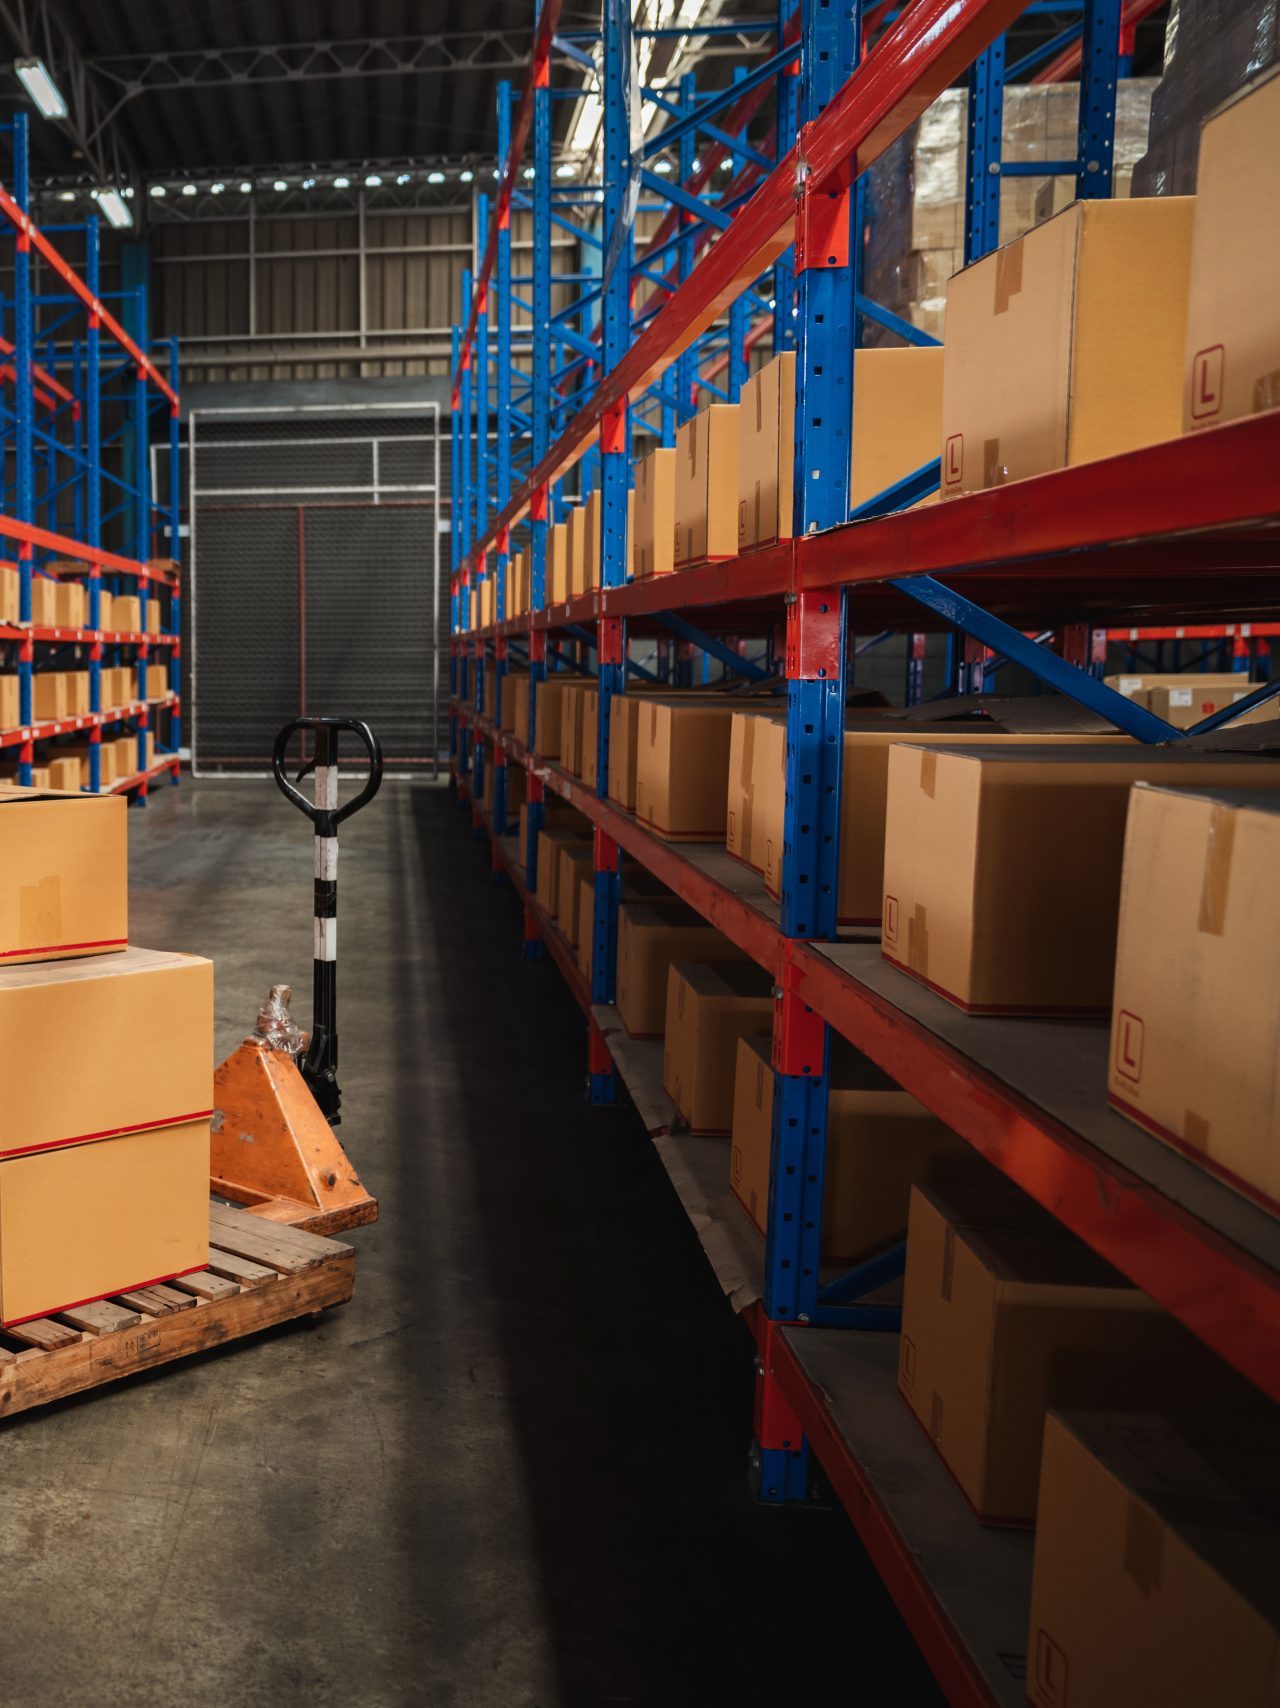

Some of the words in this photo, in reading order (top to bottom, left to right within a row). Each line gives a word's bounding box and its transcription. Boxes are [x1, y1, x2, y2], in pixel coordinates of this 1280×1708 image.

[1201, 360, 1215, 404] L
[950, 443, 958, 474] L
[1123, 1021, 1136, 1064] L
